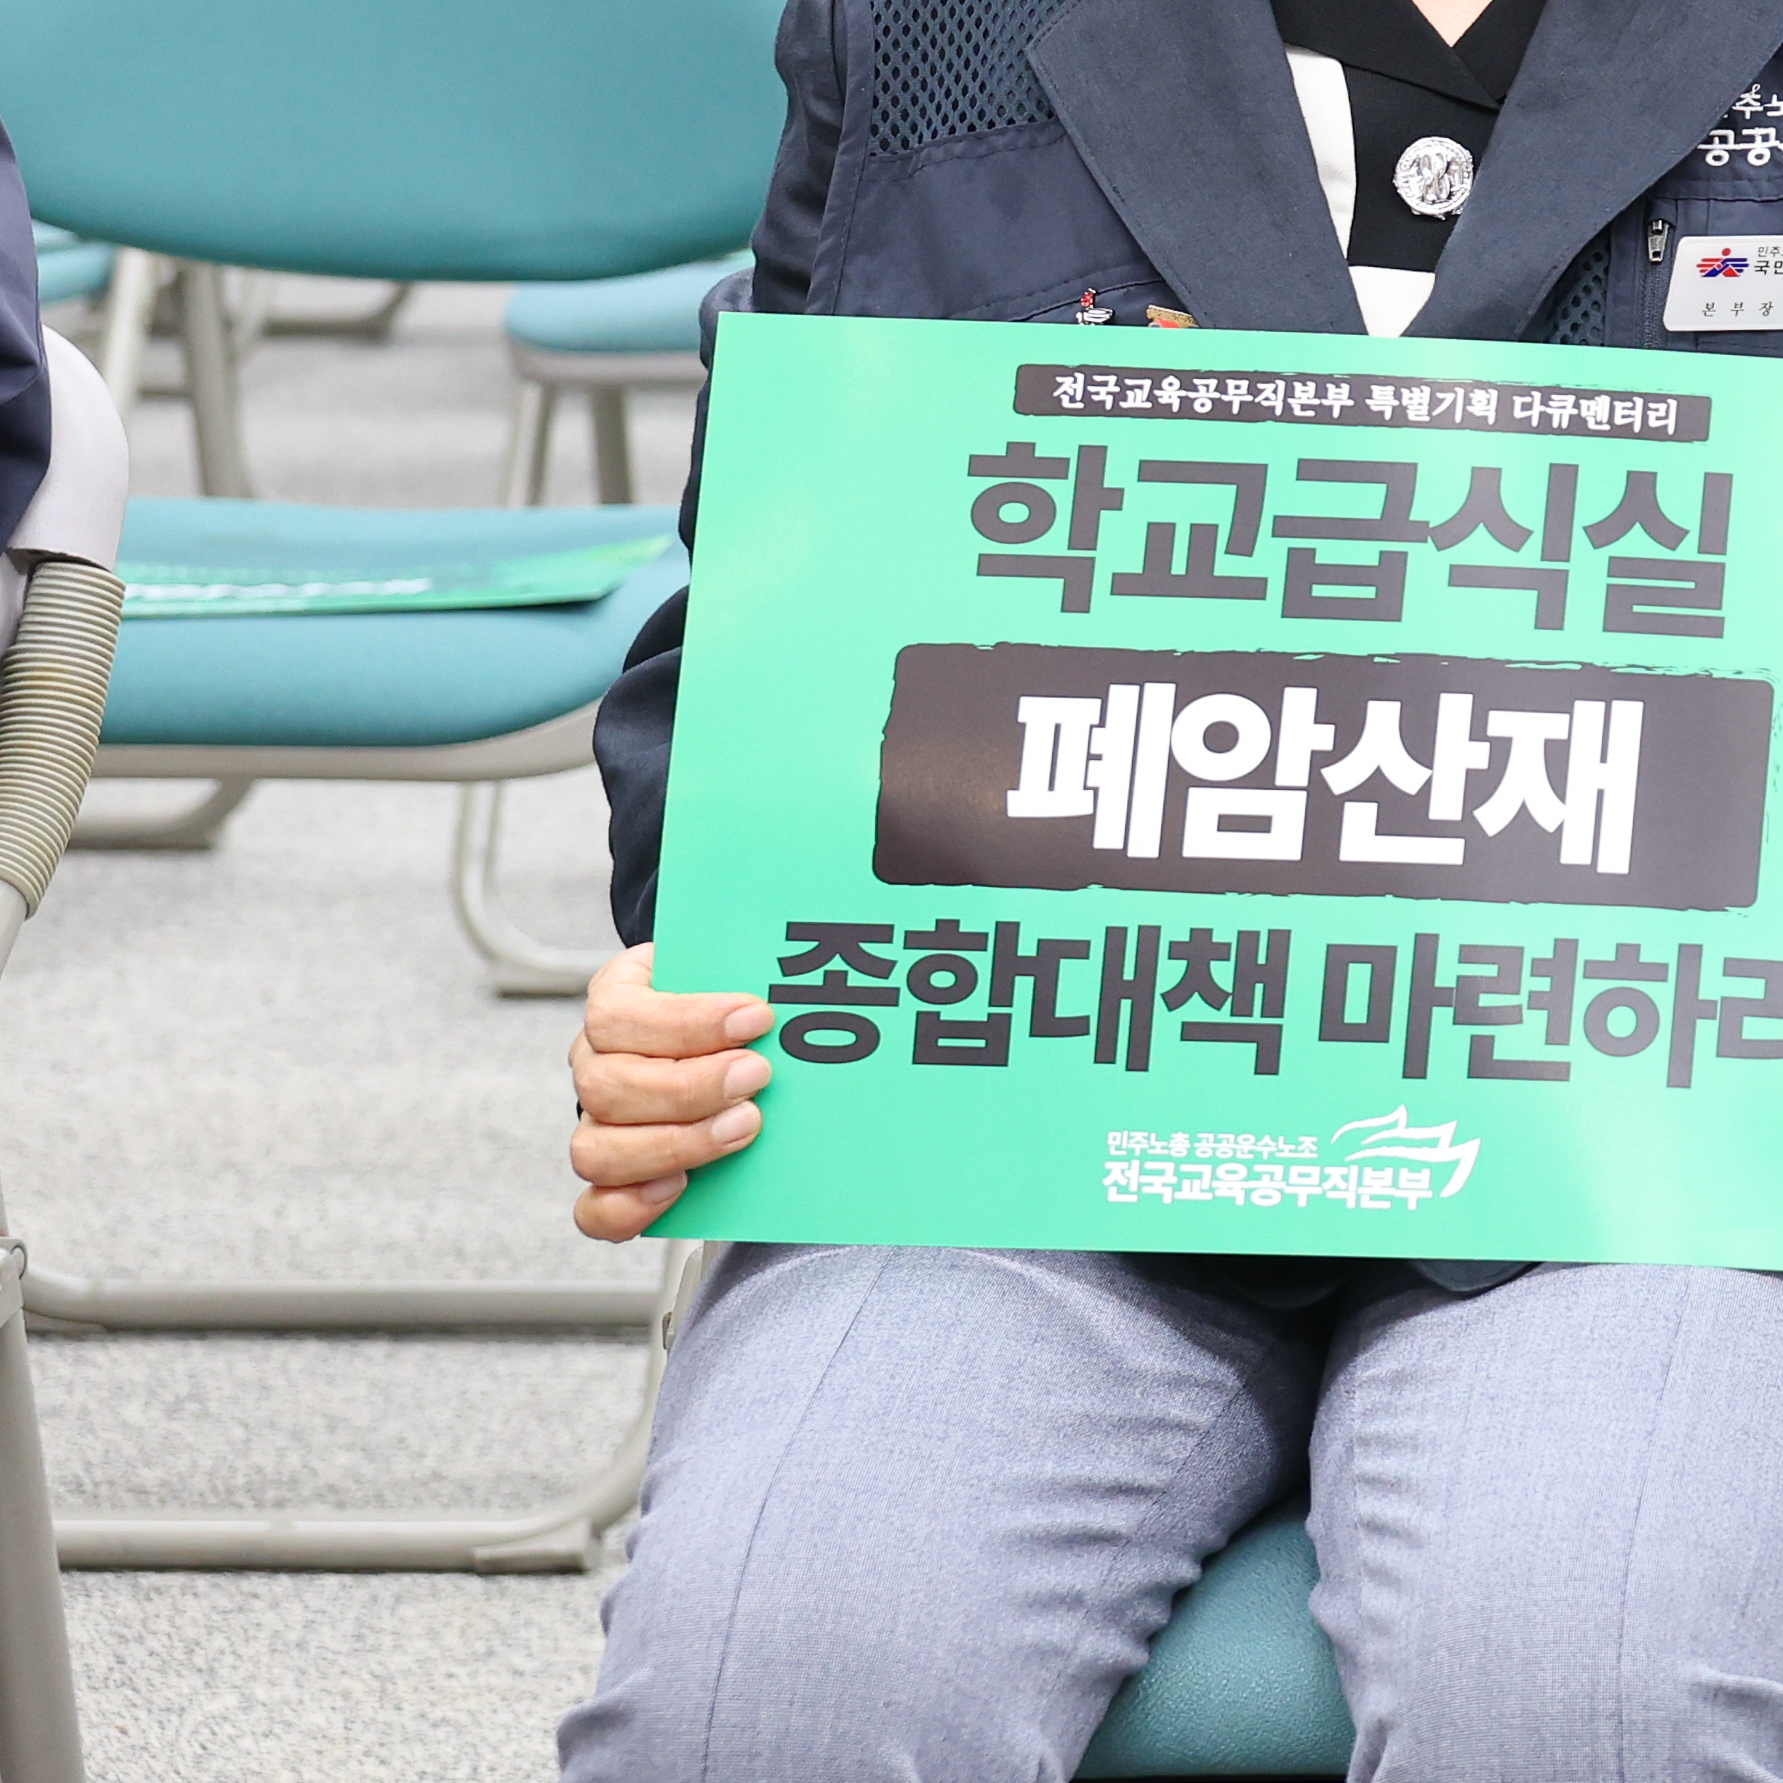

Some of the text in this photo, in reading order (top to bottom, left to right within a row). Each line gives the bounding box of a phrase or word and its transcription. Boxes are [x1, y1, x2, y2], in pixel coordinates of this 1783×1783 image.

[1052, 372, 1679, 437] 전국교육공무직본부 특별기획 다큐멘터리
[967, 441, 1735, 638] 학교급식실
[1005, 681, 1645, 876] 폐암산재
[768, 918, 1292, 1077] 종합대책
[1101, 1158, 1434, 1212] 전국교육공무직본부
[1106, 1129, 1319, 1161] 민주노총 공공운수노조
